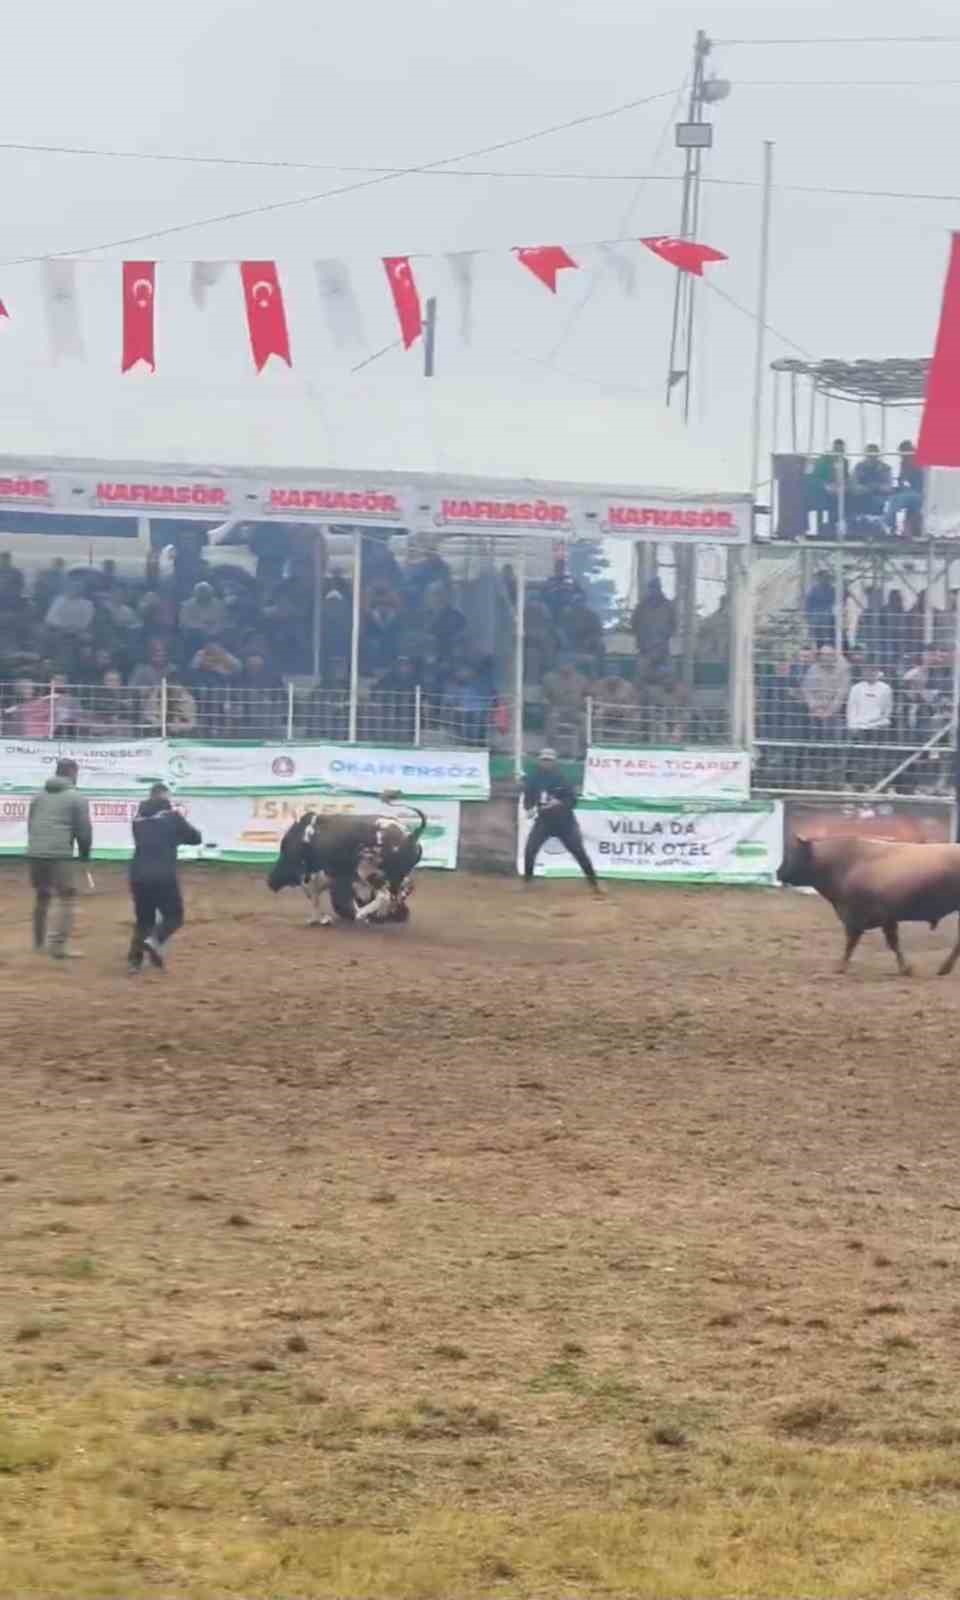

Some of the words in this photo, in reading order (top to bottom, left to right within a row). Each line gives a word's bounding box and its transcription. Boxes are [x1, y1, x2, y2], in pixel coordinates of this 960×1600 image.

[441, 498, 568, 522] KAFKASÖR
[329, 759, 396, 777] OKAN
[661, 842, 712, 857] OTEL
